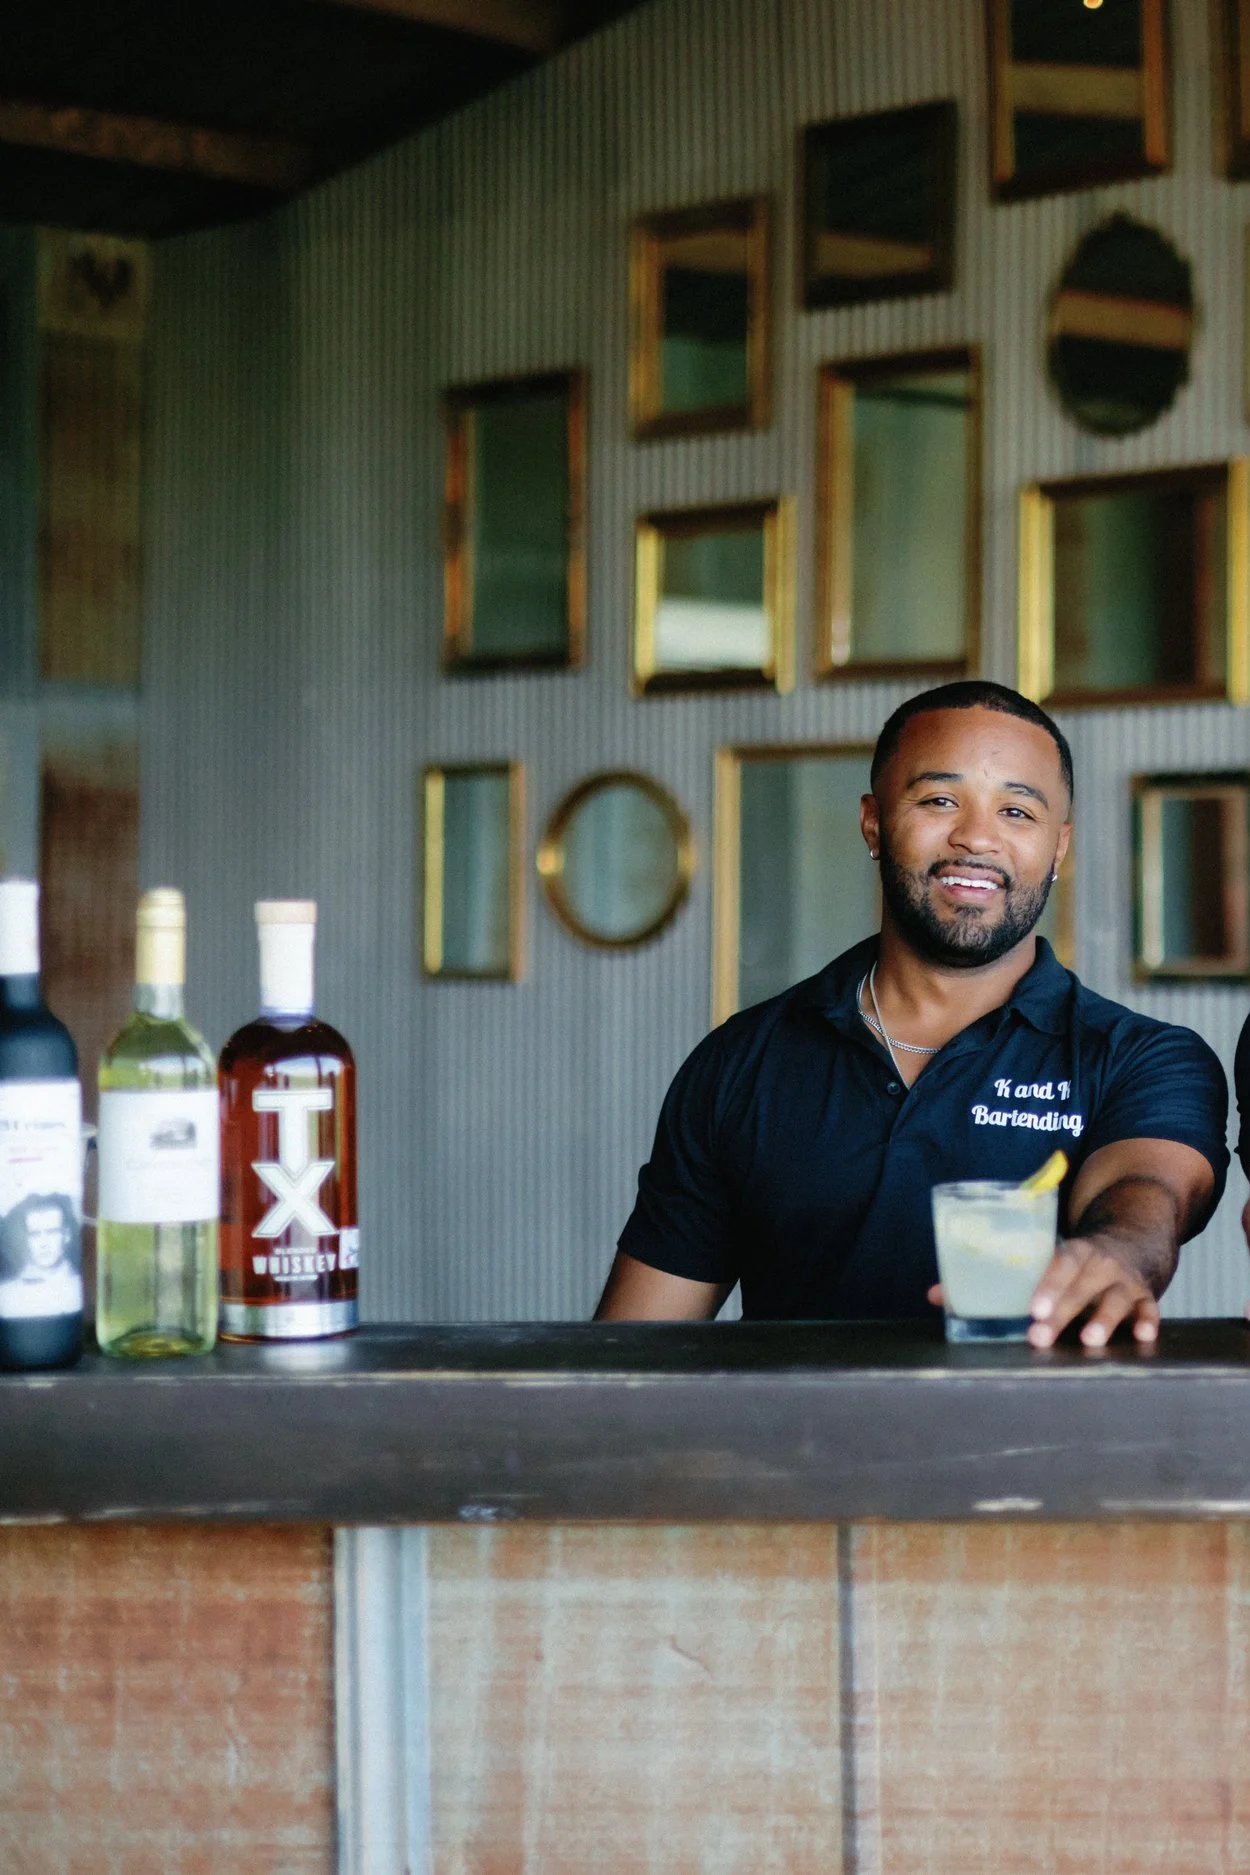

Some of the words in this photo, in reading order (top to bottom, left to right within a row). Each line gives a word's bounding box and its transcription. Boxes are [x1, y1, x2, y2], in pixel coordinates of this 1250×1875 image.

[994, 1079, 1012, 1099] K
[1015, 1082, 1055, 1100] and
[1057, 1080, 1071, 1100] K
[971, 1105, 1084, 1137] Bartending
[252, 1253, 336, 1275] WHISKEY
